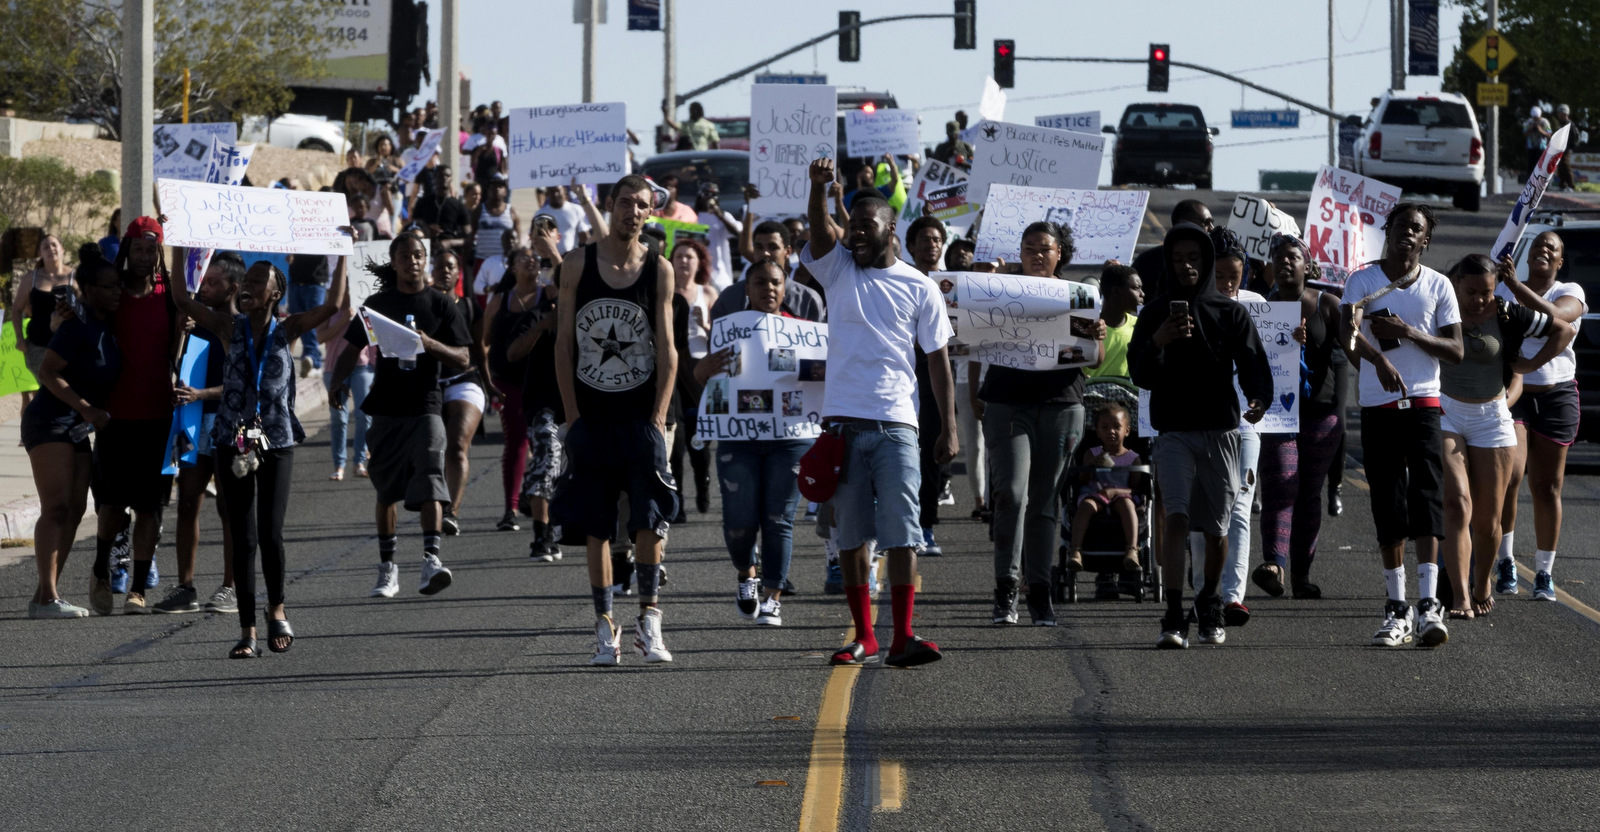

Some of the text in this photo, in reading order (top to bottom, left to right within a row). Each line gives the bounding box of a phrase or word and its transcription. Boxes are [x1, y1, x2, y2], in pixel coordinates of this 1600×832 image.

[757, 103, 831, 136] Justice
[1006, 127, 1040, 143] Black
[990, 144, 1059, 174] Justice
[218, 190, 244, 202] NO
[995, 185, 1048, 202] Justice
[198, 201, 281, 215] JUSTICE
[292, 197, 334, 208] TODAY
[220, 213, 248, 225] NO
[989, 202, 1115, 222] NO NO
[292, 216, 335, 225] MARCH
[207, 222, 277, 237] PEACE
[965, 276, 1065, 300] NO Justice
[1249, 302, 1271, 315] NO
[578, 305, 646, 337] CALIFORNIA
[967, 307, 1006, 329] NO
[713, 318, 752, 348] Justice
[752, 314, 771, 342] 4
[999, 327, 1031, 339] NO
[976, 351, 1020, 368] Police
